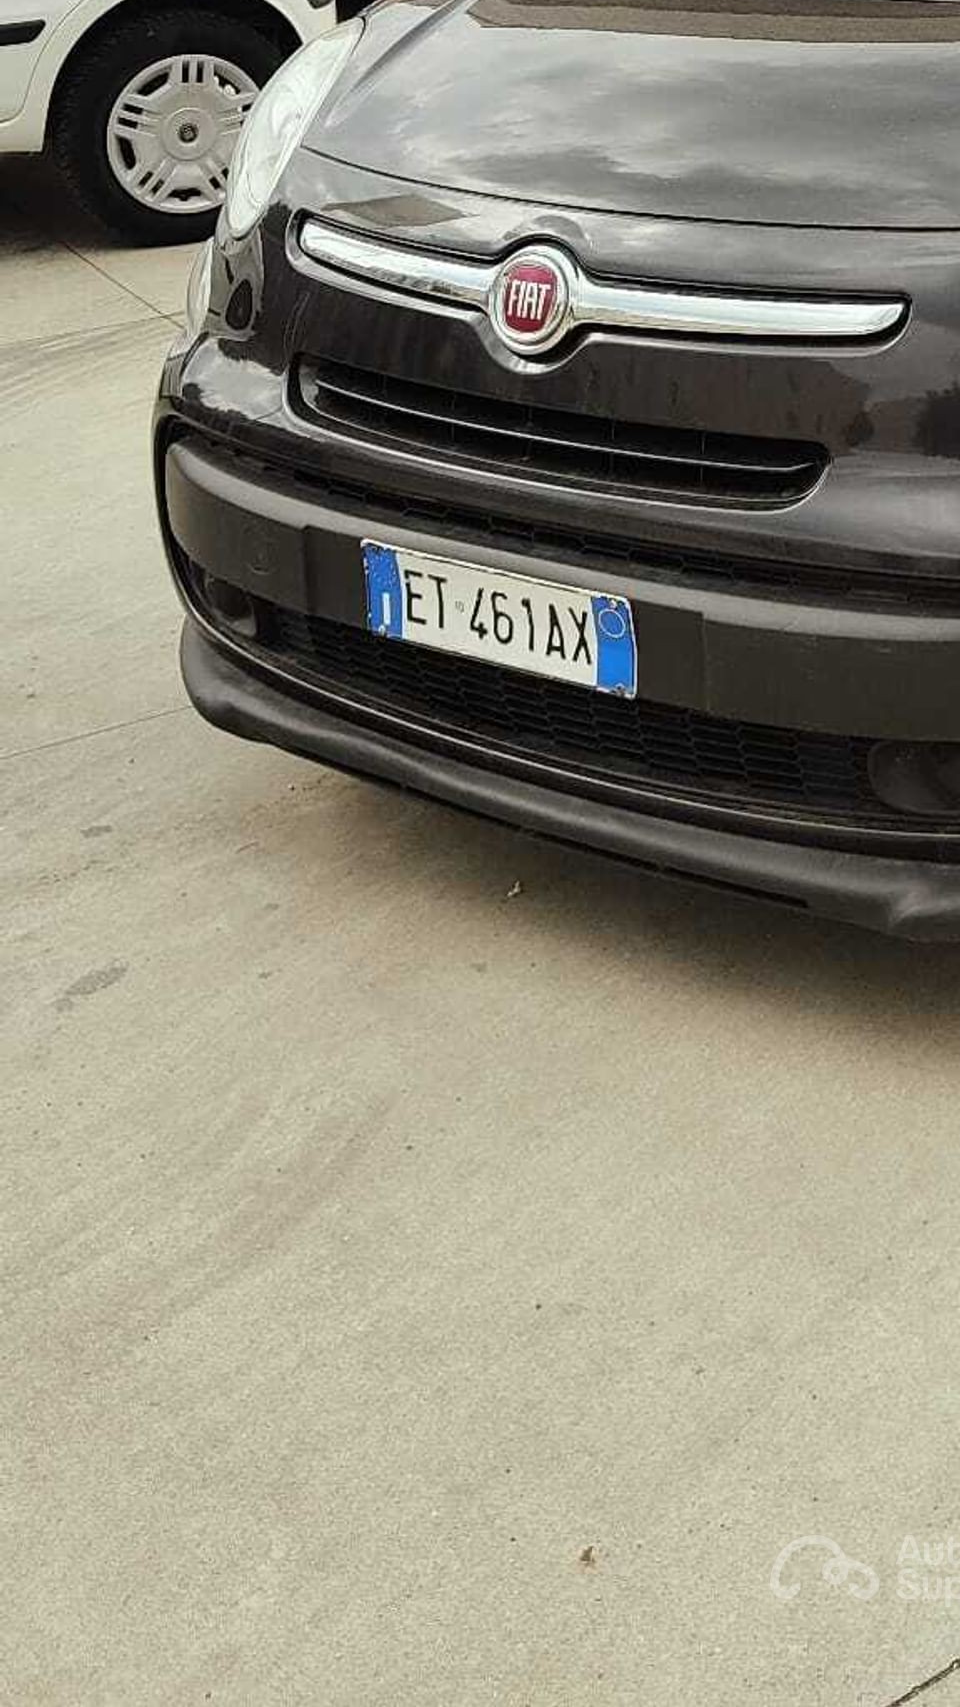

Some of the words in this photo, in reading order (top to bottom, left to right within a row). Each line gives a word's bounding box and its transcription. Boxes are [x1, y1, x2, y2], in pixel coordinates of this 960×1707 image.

[507, 279, 551, 321] FIAT
[403, 569, 447, 629] ET
[469, 587, 592, 665] 461AX
